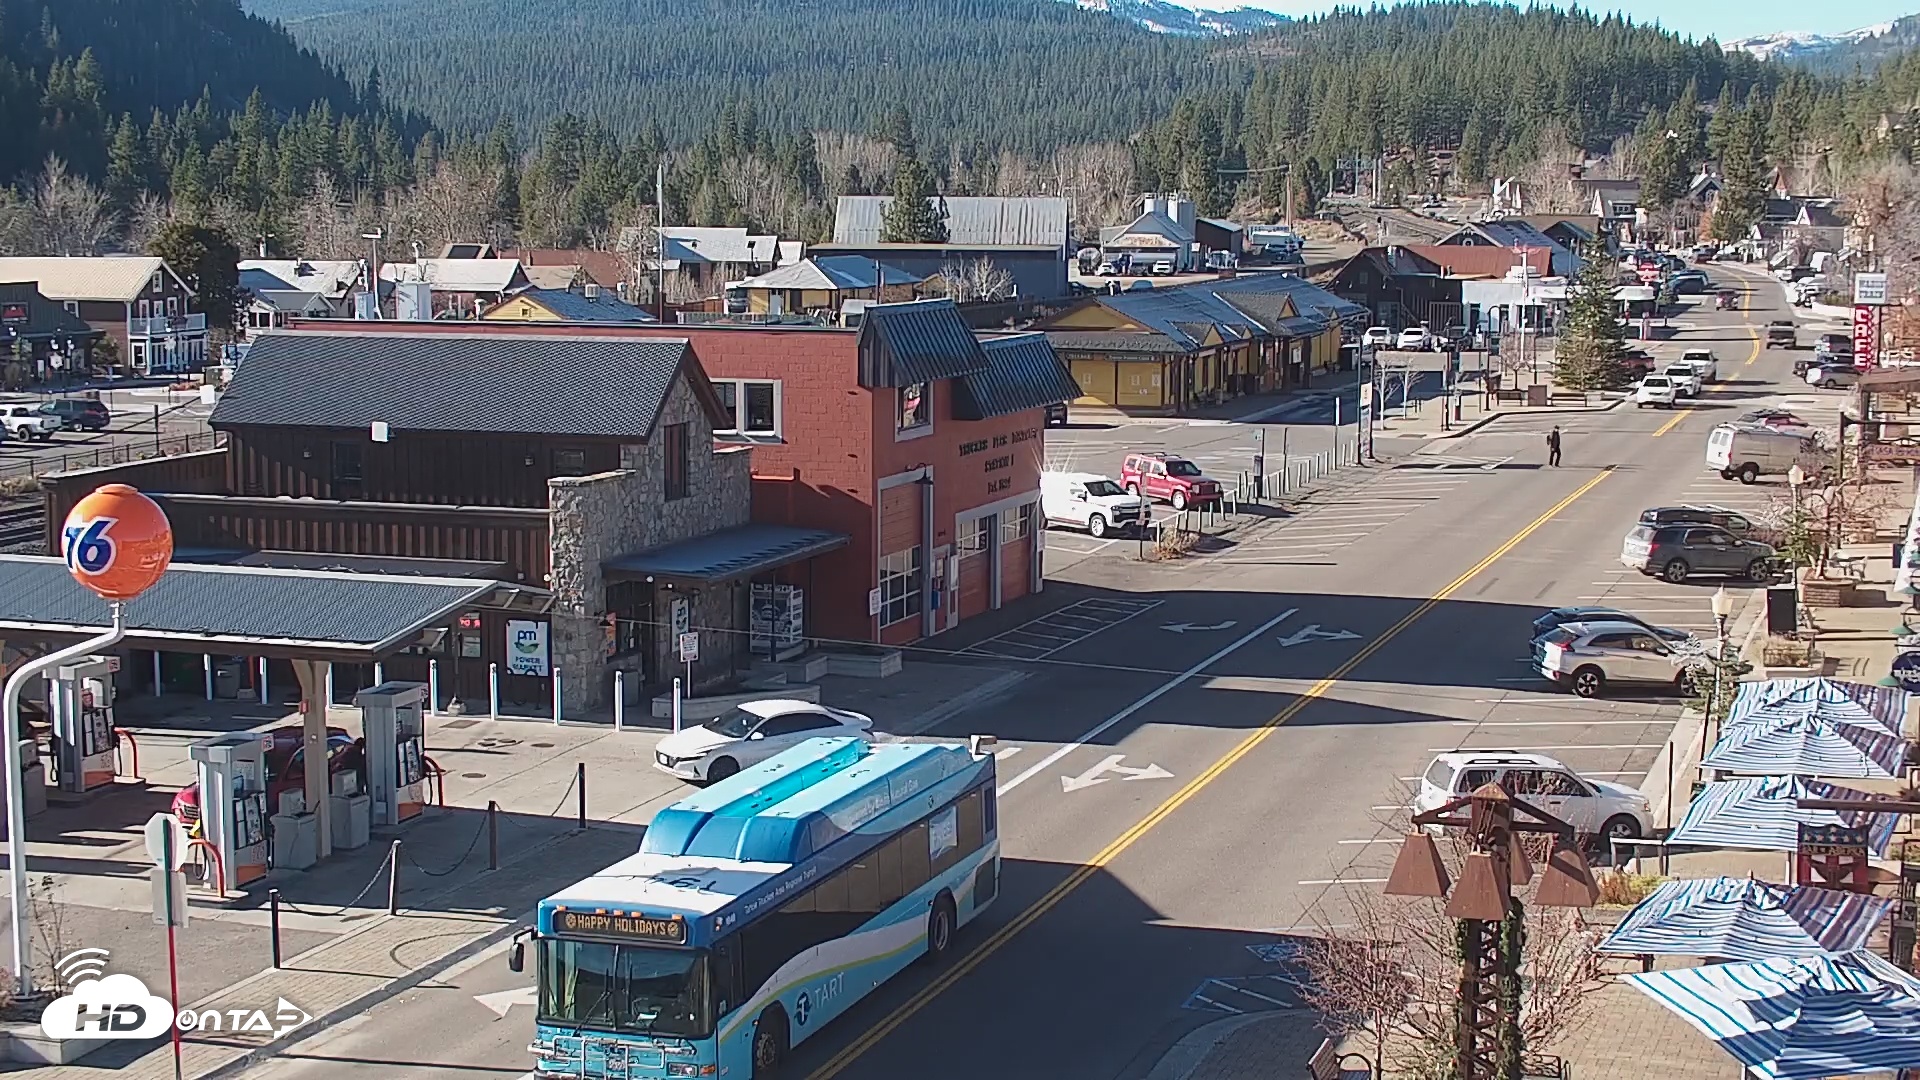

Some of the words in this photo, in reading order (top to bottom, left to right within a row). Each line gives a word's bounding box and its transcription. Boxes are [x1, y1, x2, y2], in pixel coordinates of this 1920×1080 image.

[1854, 309, 1868, 366] CAFE
[64, 517, 116, 574] 76
[517, 630, 536, 643] pm
[577, 914, 610, 929] HAPPY
[615, 918, 666, 935] HOLIDAYS
[815, 972, 844, 1008] TART
